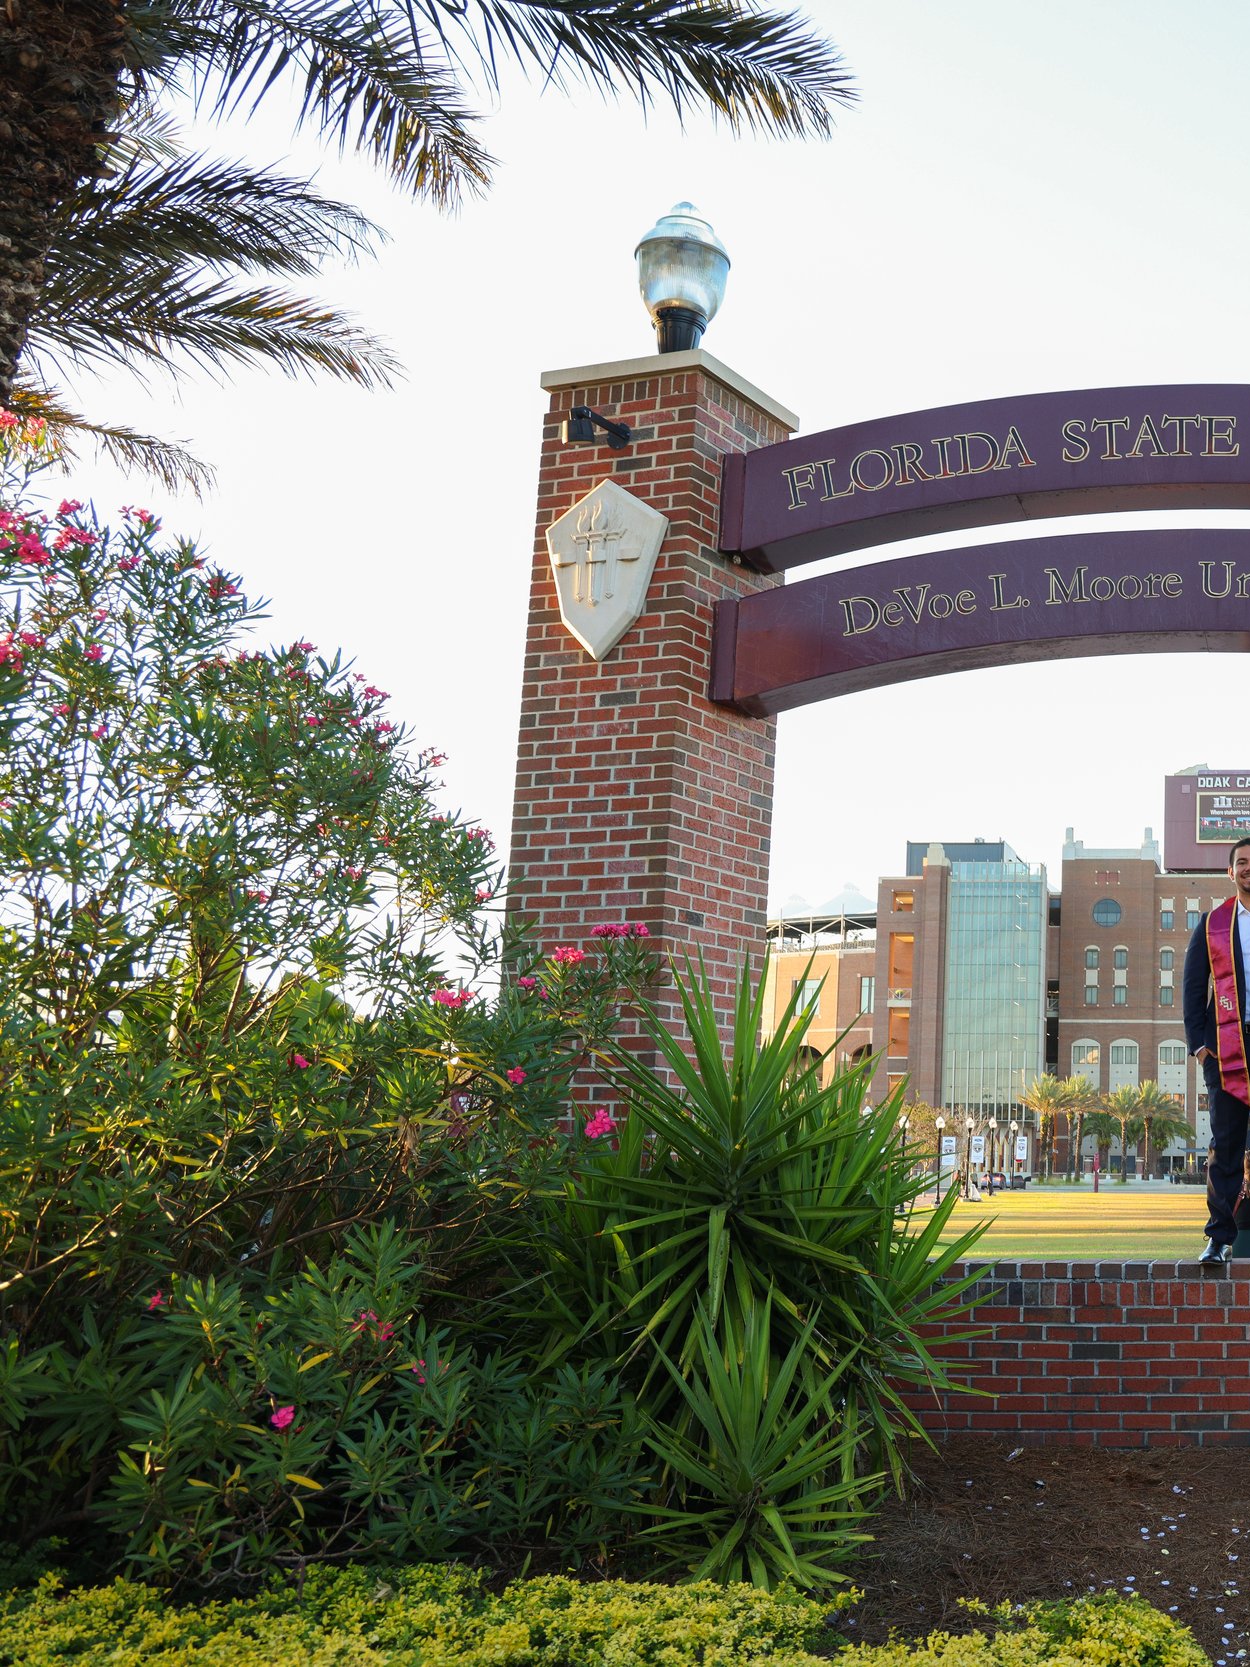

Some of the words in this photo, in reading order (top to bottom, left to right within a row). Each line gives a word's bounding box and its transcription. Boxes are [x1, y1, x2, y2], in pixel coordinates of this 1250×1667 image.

[782, 426, 1036, 510] FLORIDA
[1062, 414, 1240, 463] STATE
[839, 583, 977, 637] DeVoe
[989, 573, 1030, 612] L.
[1045, 565, 1183, 605] Moore
[1198, 776, 1230, 788] DOAK
[1219, 995, 1233, 1011] FSU
